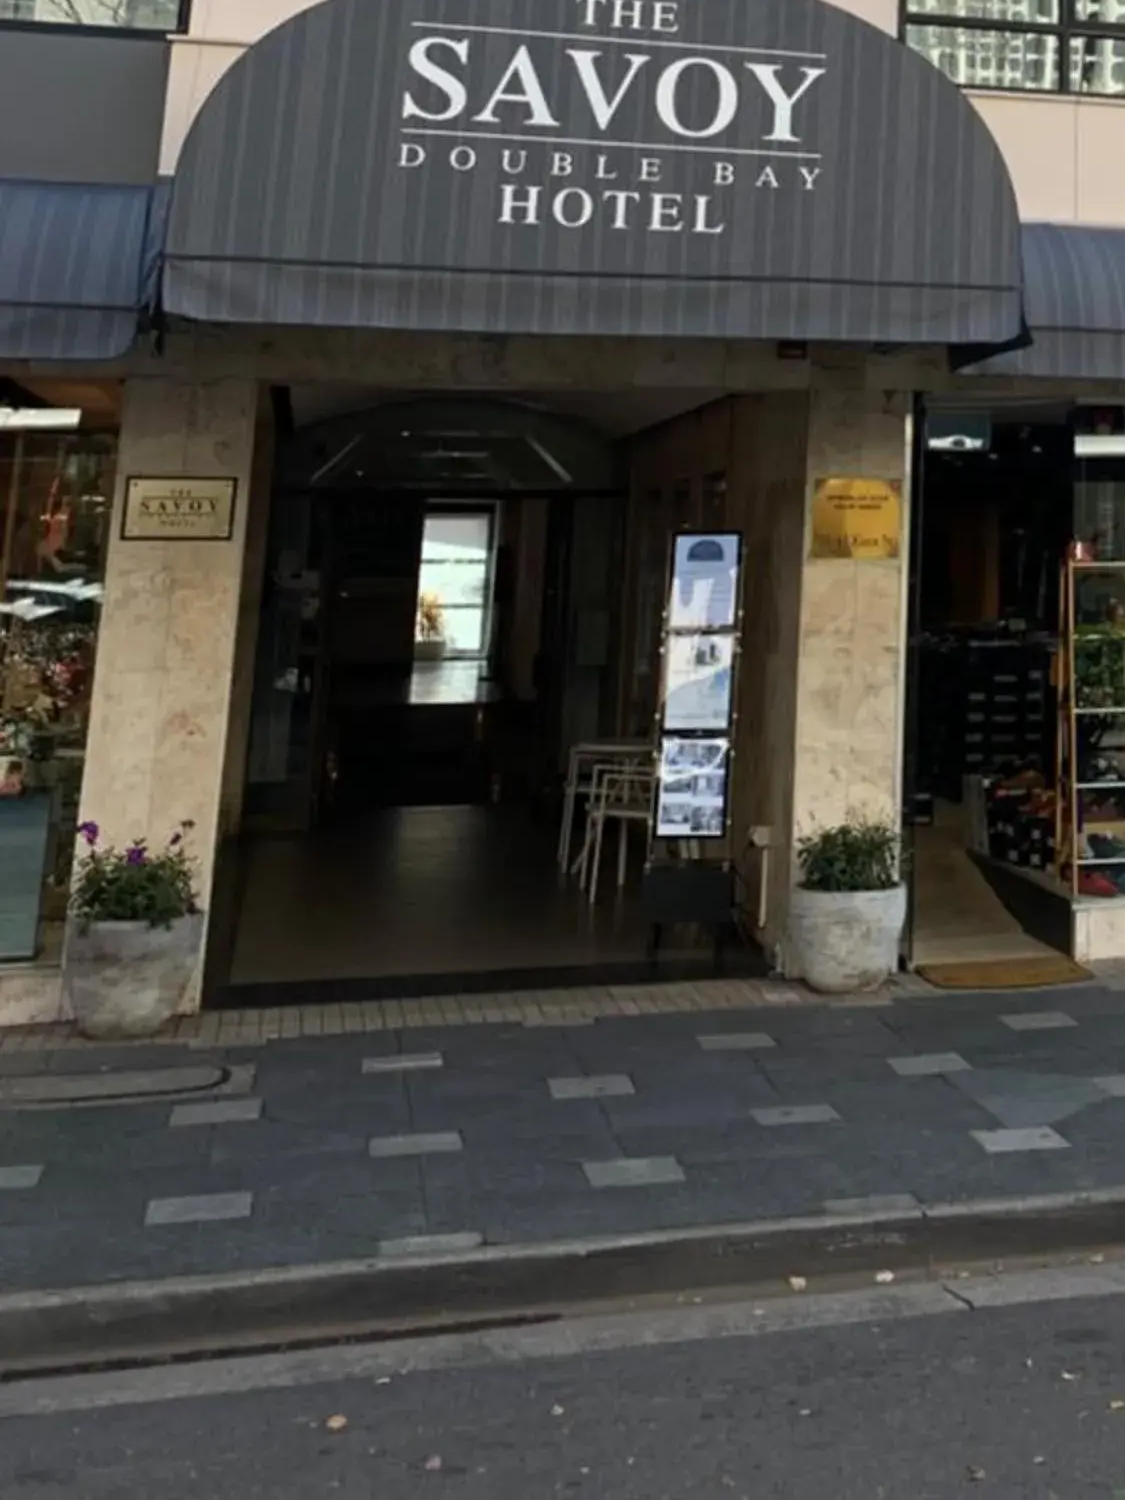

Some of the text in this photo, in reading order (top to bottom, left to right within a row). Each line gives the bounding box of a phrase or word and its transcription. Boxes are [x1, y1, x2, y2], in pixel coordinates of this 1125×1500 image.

[401, 35, 827, 144] SAVOY
[399, 143, 823, 191] DOUBLE BAY
[499, 185, 725, 235] HOTEL
[139, 498, 216, 512] SAVOY
